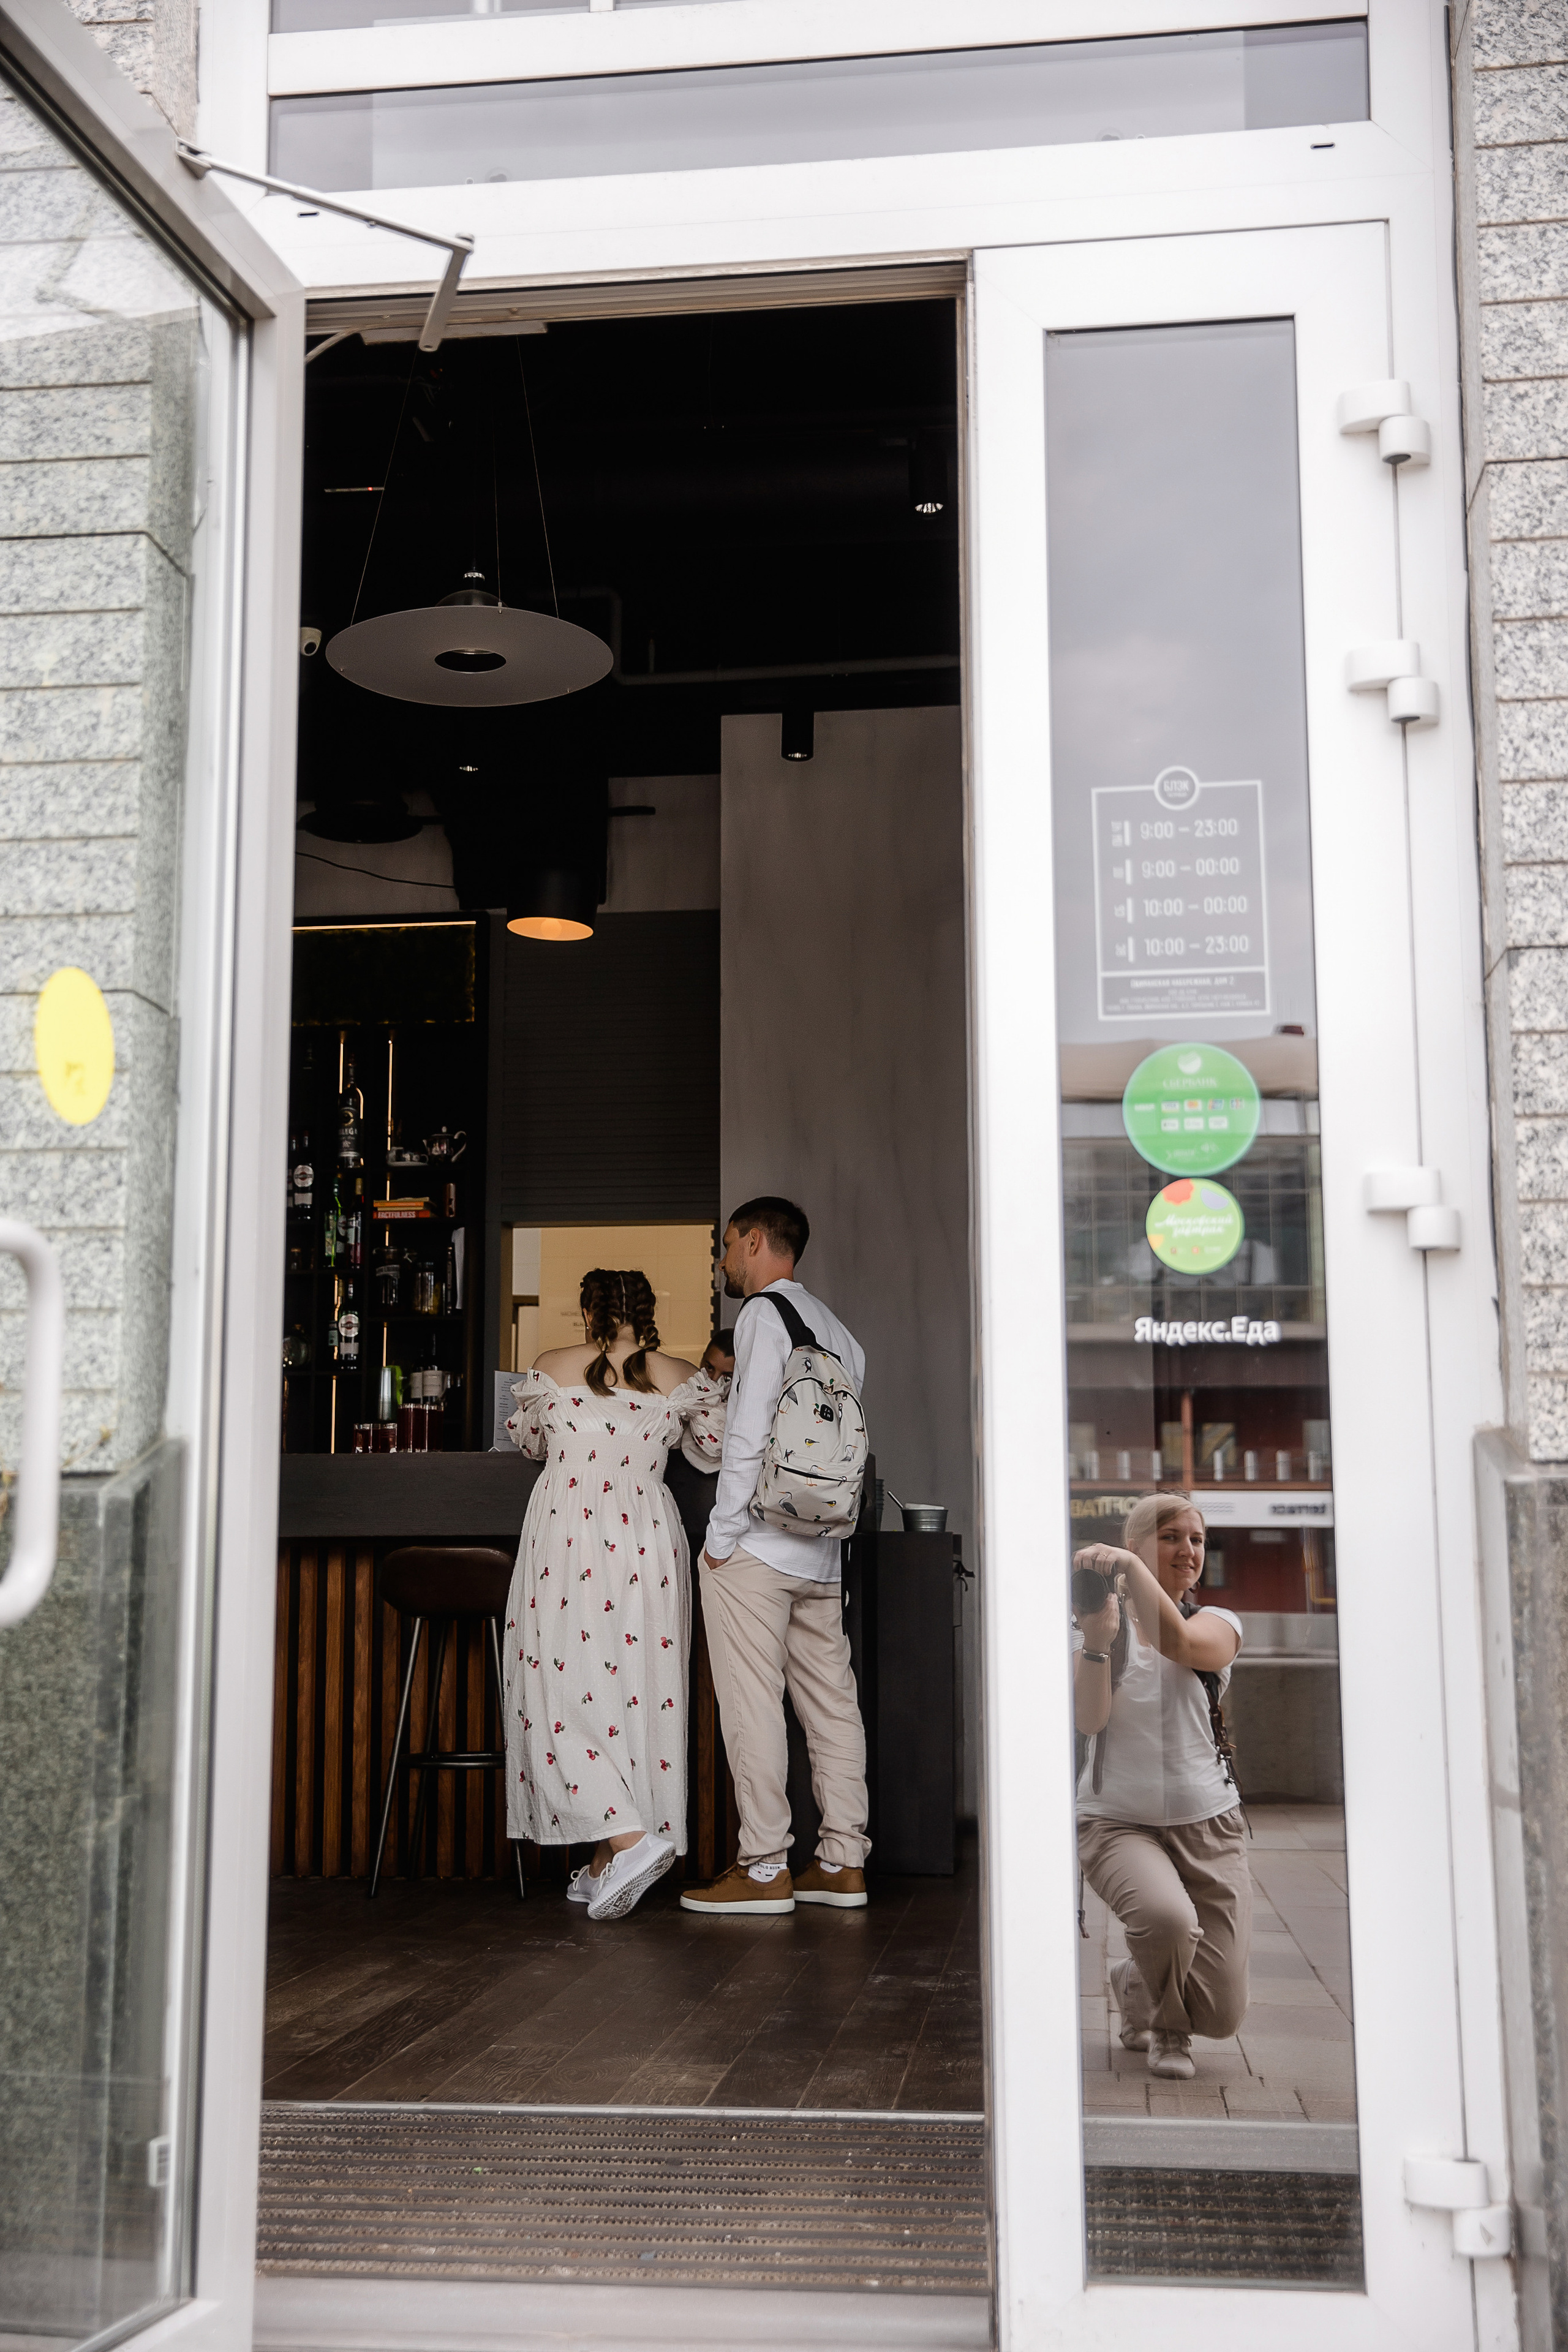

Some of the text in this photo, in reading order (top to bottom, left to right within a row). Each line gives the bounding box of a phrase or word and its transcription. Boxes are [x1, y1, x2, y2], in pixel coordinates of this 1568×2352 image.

[1140, 821, 1174, 840] 9:00
[1194, 818, 1238, 837] 23:00
[1142, 860, 1175, 878] 9:00
[1196, 857, 1239, 876] 00:00
[1144, 897, 1183, 917] 10:00
[1204, 895, 1247, 915] 00:00
[1145, 937, 1185, 956] 10:00
[1205, 934, 1249, 955] 23:00
[1134, 1316, 1282, 1346] Яндекс.Еда
